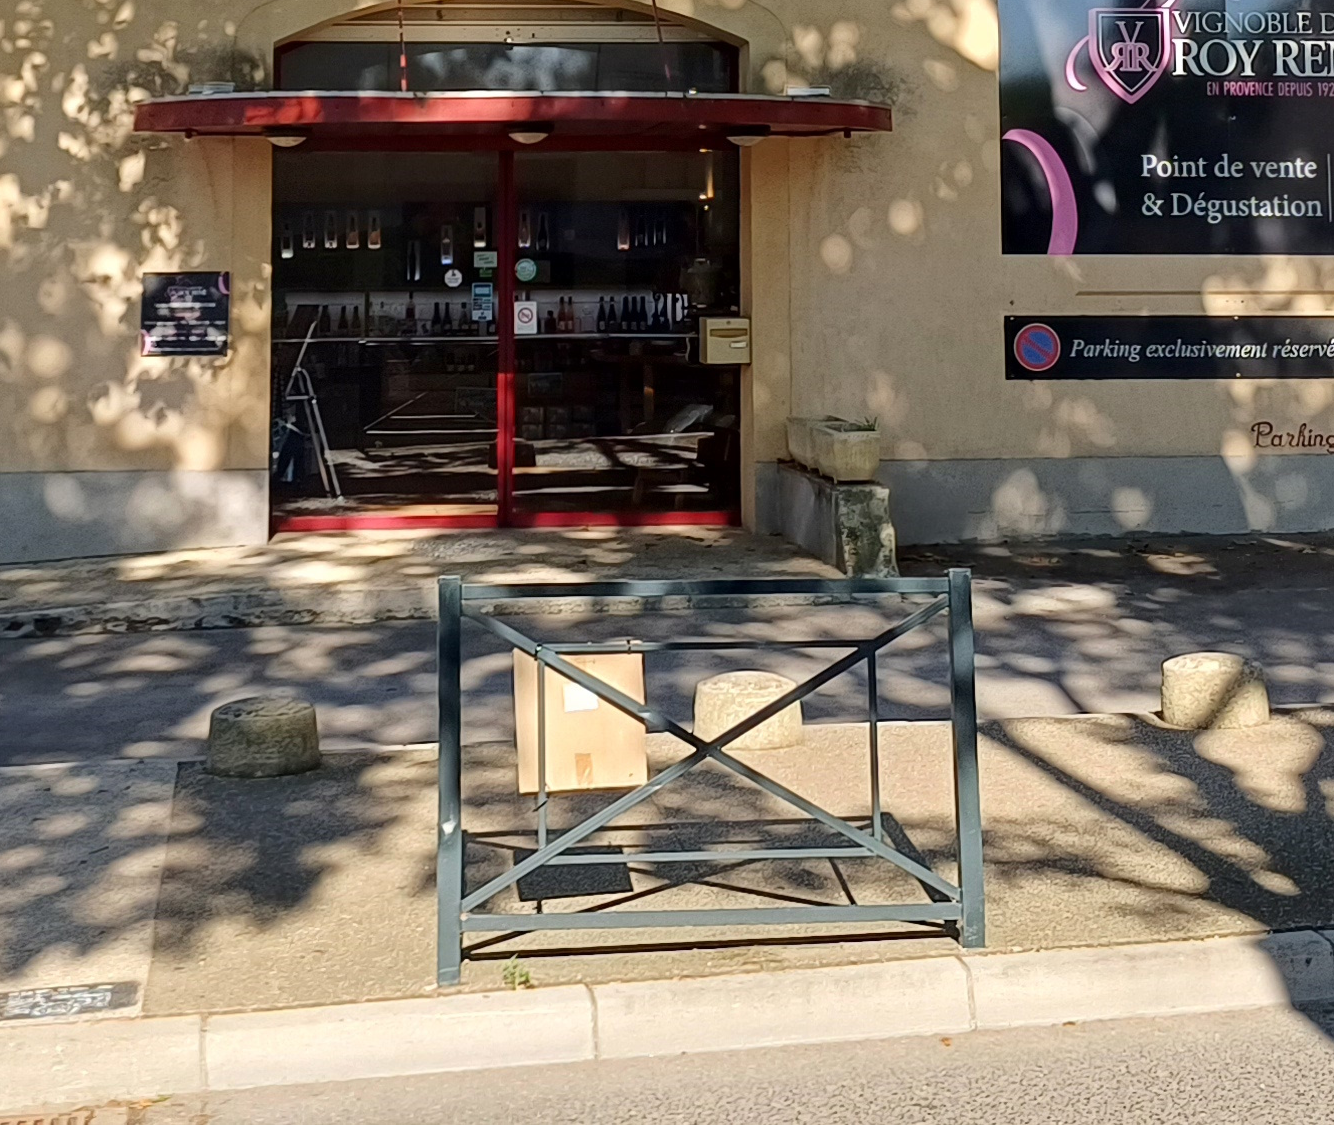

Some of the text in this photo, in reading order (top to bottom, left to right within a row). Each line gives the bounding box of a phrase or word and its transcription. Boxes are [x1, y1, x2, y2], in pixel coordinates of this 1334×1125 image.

[1172, 10, 1312, 34] VIGNOBLE
[1172, 38, 1265, 77] ROY
[1206, 81, 1220, 96] EN
[1223, 81, 1274, 97] PROVENCE
[1277, 82, 1313, 97] DEPUIS
[1140, 154, 1318, 178] Point de vente
[1141, 192, 1324, 224] & Dégustation
[1069, 339, 1142, 363] Parking
[1145, 339, 1268, 359] exclusivement
